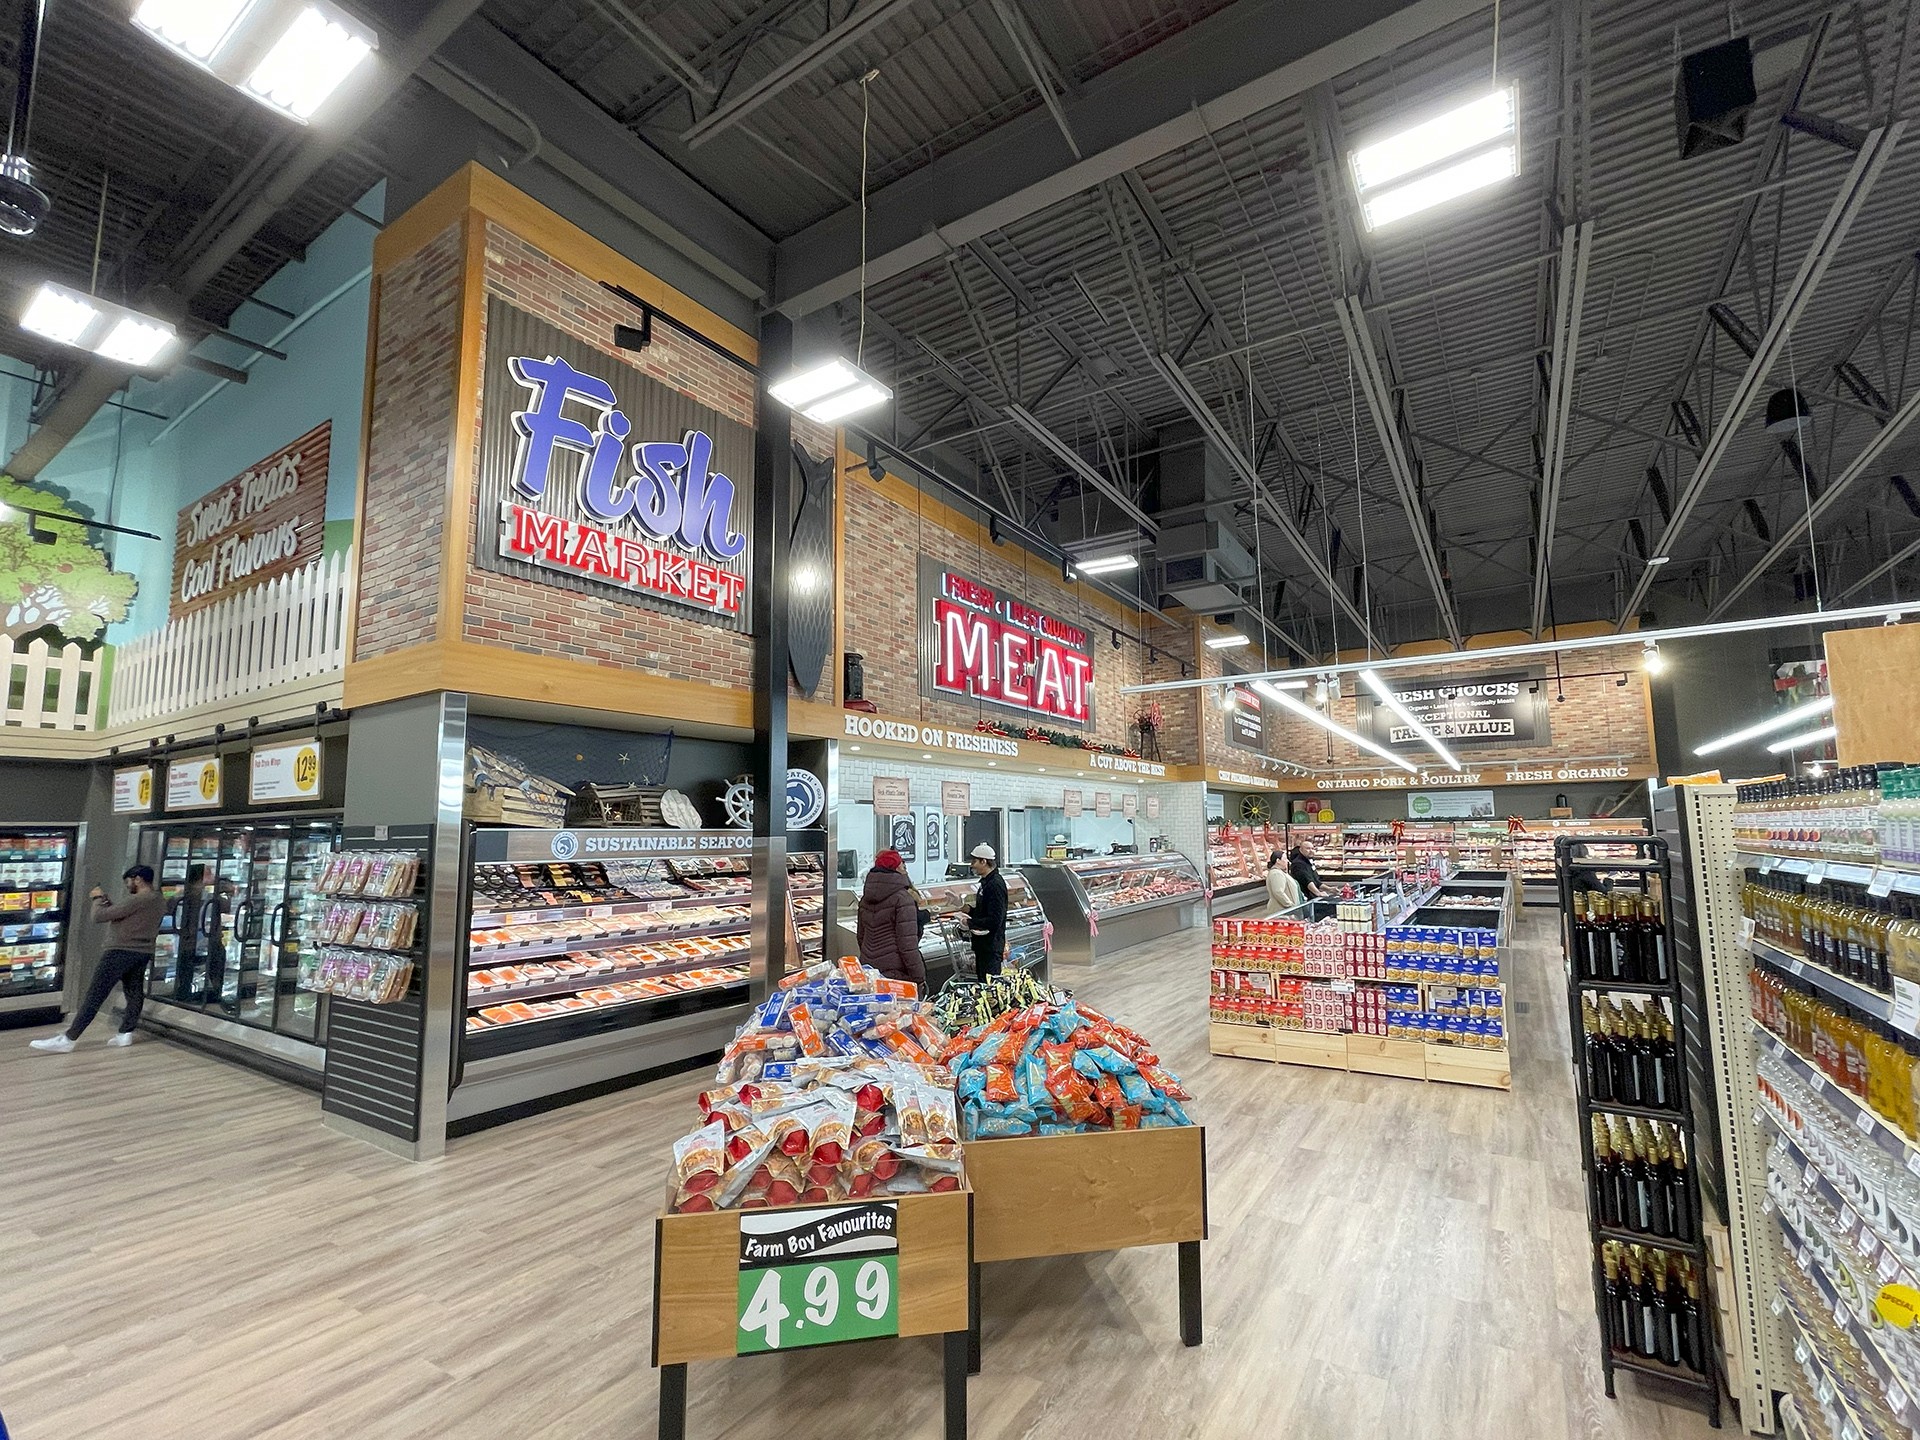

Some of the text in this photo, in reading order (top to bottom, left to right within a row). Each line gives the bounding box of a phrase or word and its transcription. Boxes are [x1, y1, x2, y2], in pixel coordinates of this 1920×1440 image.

[508, 355, 746, 563] Fish
[187, 453, 302, 548] Sweet Treats
[182, 515, 300, 603] Cool Flavours
[500, 500, 746, 617] MARKET
[933, 598, 1095, 724] MEAT
[1381, 681, 1520, 706] RESH CHOICES
[844, 714, 1019, 758] HOOKED ON FRESHNESS
[1413, 709, 1491, 723] XCEPTIONAL
[1444, 722, 1454, 734] &
[1457, 721, 1511, 734] VALUE
[1089, 753, 1097, 767] A
[1097, 755, 1113, 769] CUT
[1114, 759, 1137, 773] ABOVE
[1137, 762, 1150, 774] THE
[1316, 773, 1482, 790] ONTARIO PORK & POULTRY
[1505, 767, 1630, 783] FRESH ORGANIC
[585, 836, 696, 852] SUSTAINABLE
[745, 1211, 893, 1257] Farm Boy Favourites
[739, 1261, 891, 1349] 4.99
